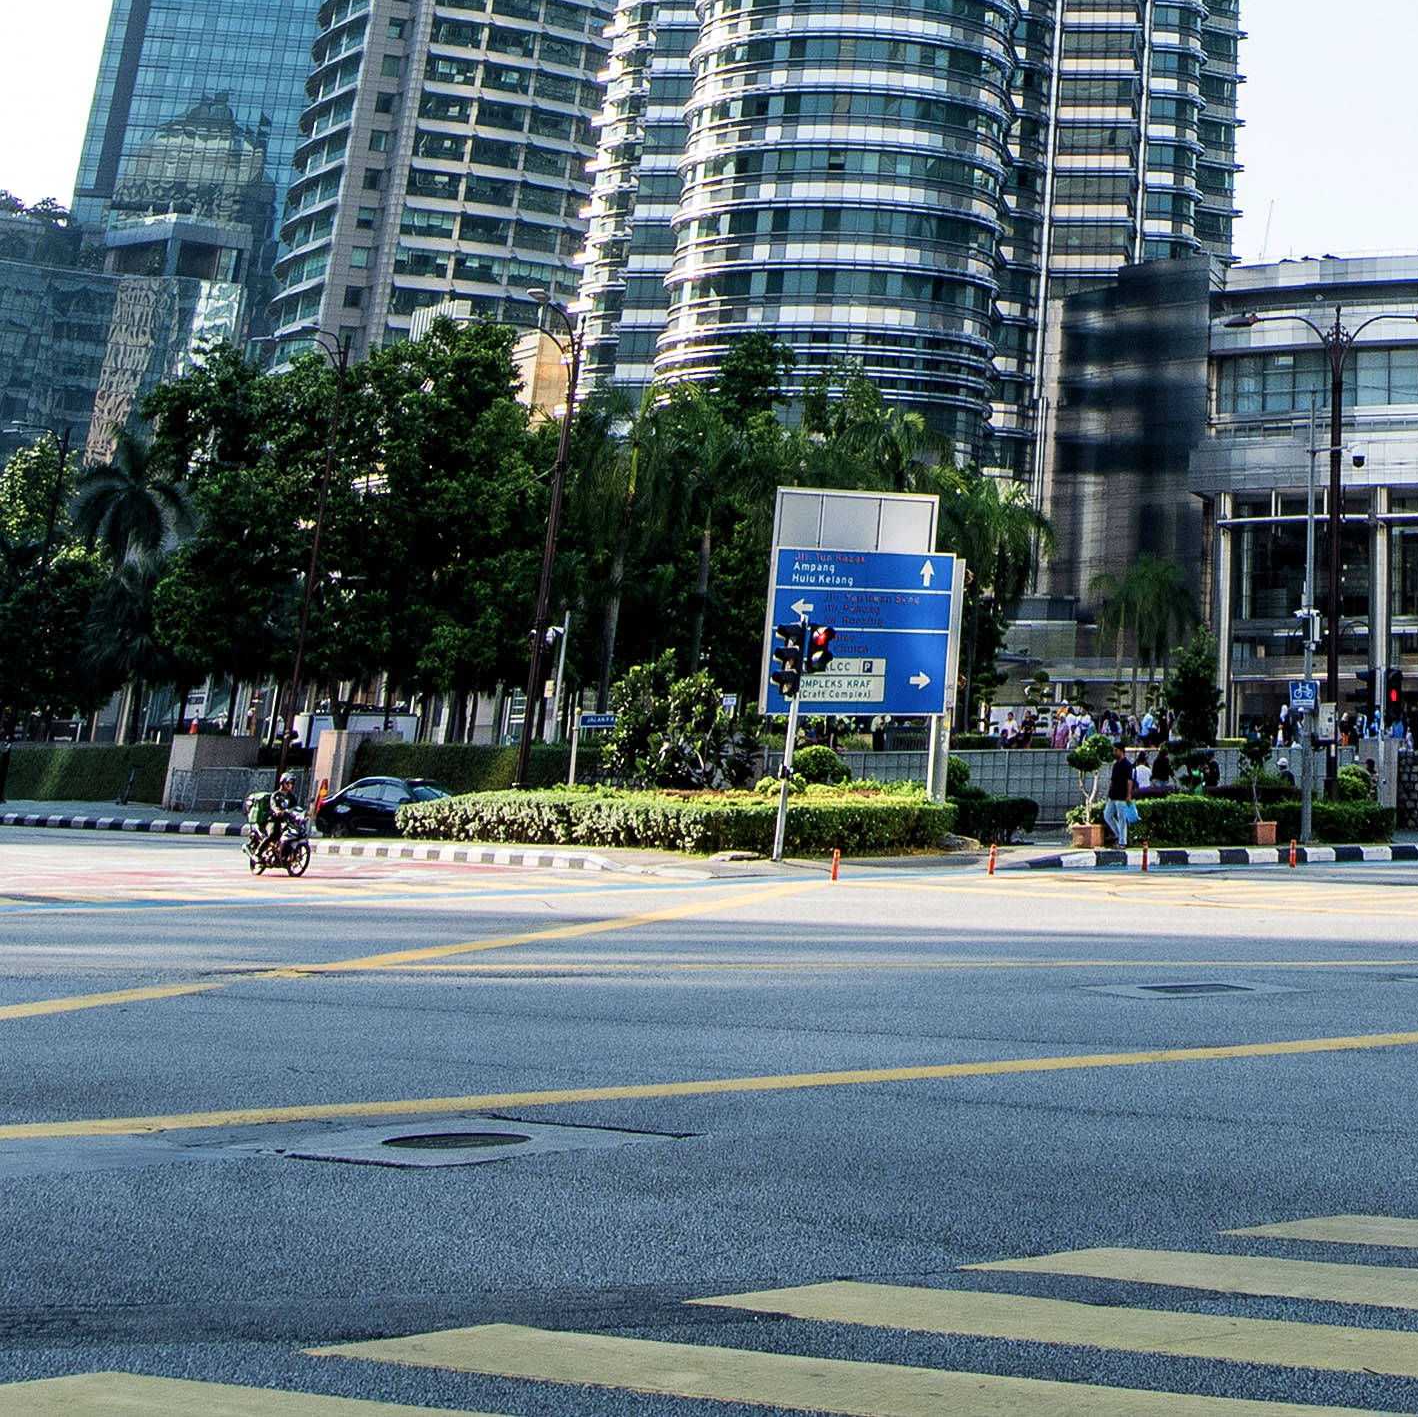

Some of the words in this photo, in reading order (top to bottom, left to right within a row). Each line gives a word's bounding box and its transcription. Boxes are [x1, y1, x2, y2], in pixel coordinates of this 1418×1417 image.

[816, 552, 832, 562] Tun
[793, 561, 836, 574] Ampang
[792, 573, 816, 583] Hulu
[819, 574, 854, 587] Kelang
[895, 594, 919, 606] Seng
[800, 679, 843, 689] OMPLEKS
[847, 679, 872, 689] KRAF
[829, 689, 872, 700] Complex)
